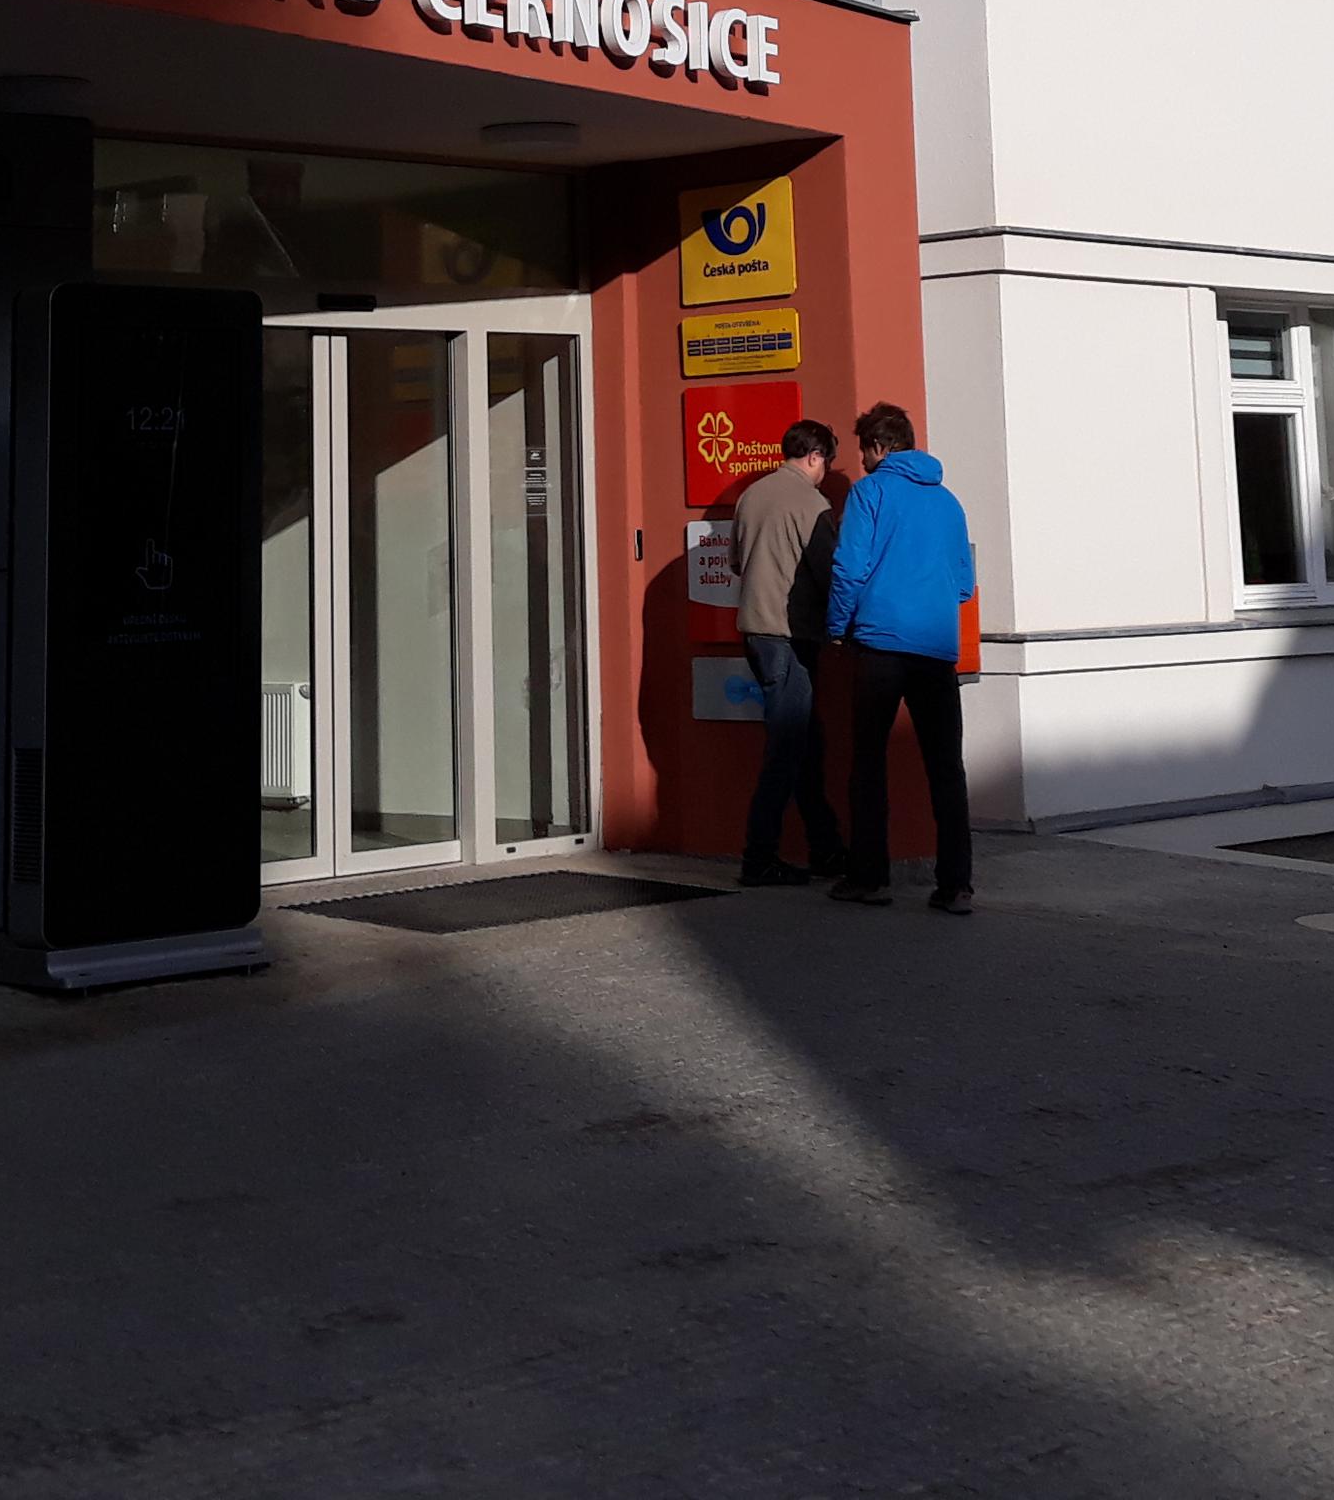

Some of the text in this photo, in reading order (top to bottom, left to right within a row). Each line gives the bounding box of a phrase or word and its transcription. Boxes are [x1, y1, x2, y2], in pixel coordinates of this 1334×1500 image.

[703, 258, 769, 278] Česká pošta
[737, 440, 782, 455] Poštovn
[699, 534, 730, 547] Banko
[699, 556, 706, 566] a
